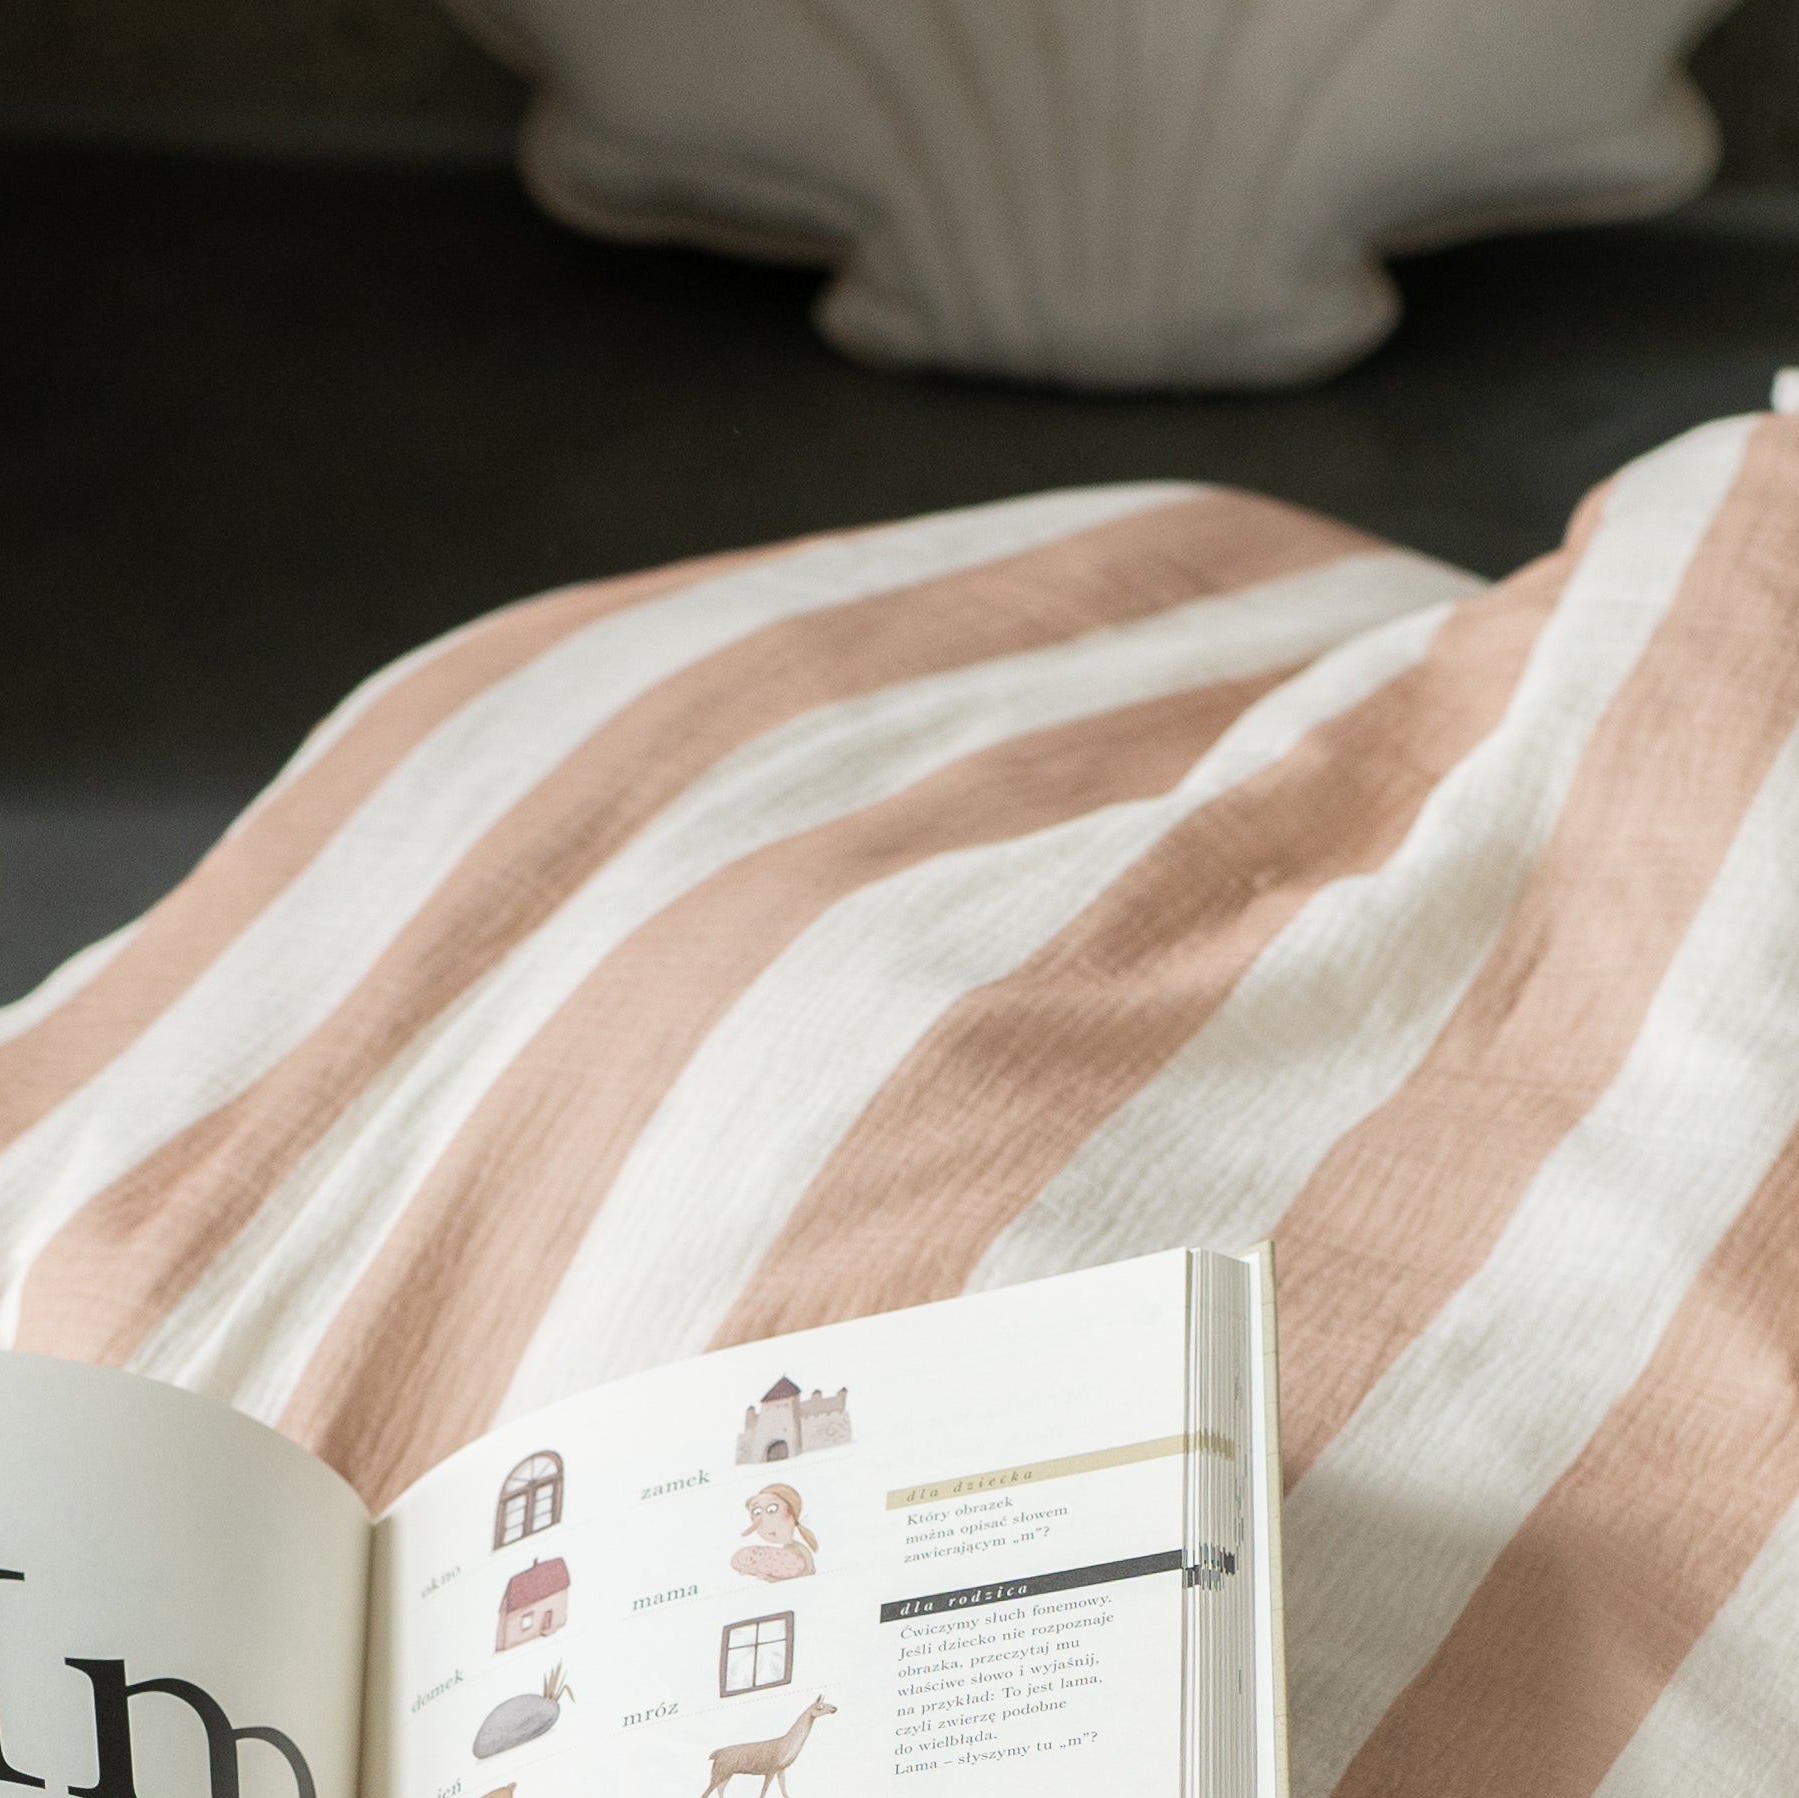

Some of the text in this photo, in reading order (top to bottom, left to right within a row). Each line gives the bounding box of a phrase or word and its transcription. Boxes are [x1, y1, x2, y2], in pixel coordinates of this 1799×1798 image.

[640, 1469, 712, 1500] zamek
[906, 1469, 1034, 1503] dla dziecka
[905, 1505, 1068, 1545] można opisać słowem
[906, 1496, 1014, 1527] Który obrazek
[903, 1535, 1007, 1564] zawierającym
[420, 1565, 462, 1599] okno
[632, 1584, 700, 1611] mama
[900, 1585, 1029, 1616] dla rodzica
[900, 1594, 1112, 1640] Ćwiczymy słuch fonemowy.
[898, 1612, 1115, 1662] Jeśli dziecko nie rozpoznaje
[970, 1643, 1050, 1669] przeczytaj
[1056, 1638, 1081, 1651] mu
[410, 1669, 465, 1714] domek
[897, 1678, 965, 1697] właściwe
[970, 1669, 1013, 1686] słowo
[623, 1702, 680, 1728] mróz
[896, 1705, 915, 1718] na
[921, 1692, 995, 1716] przykład:
[1002, 1686, 1022, 1699] To
[1026, 1681, 1054, 1697] jest
[895, 1699, 1067, 1737] czyli zwierzę podobne
[894, 1730, 998, 1756] do wielbłąda.
[894, 1760, 938, 1776] Lama
[958, 1745, 1031, 1765] słyszymy
[1036, 1741, 1053, 1752] tu
